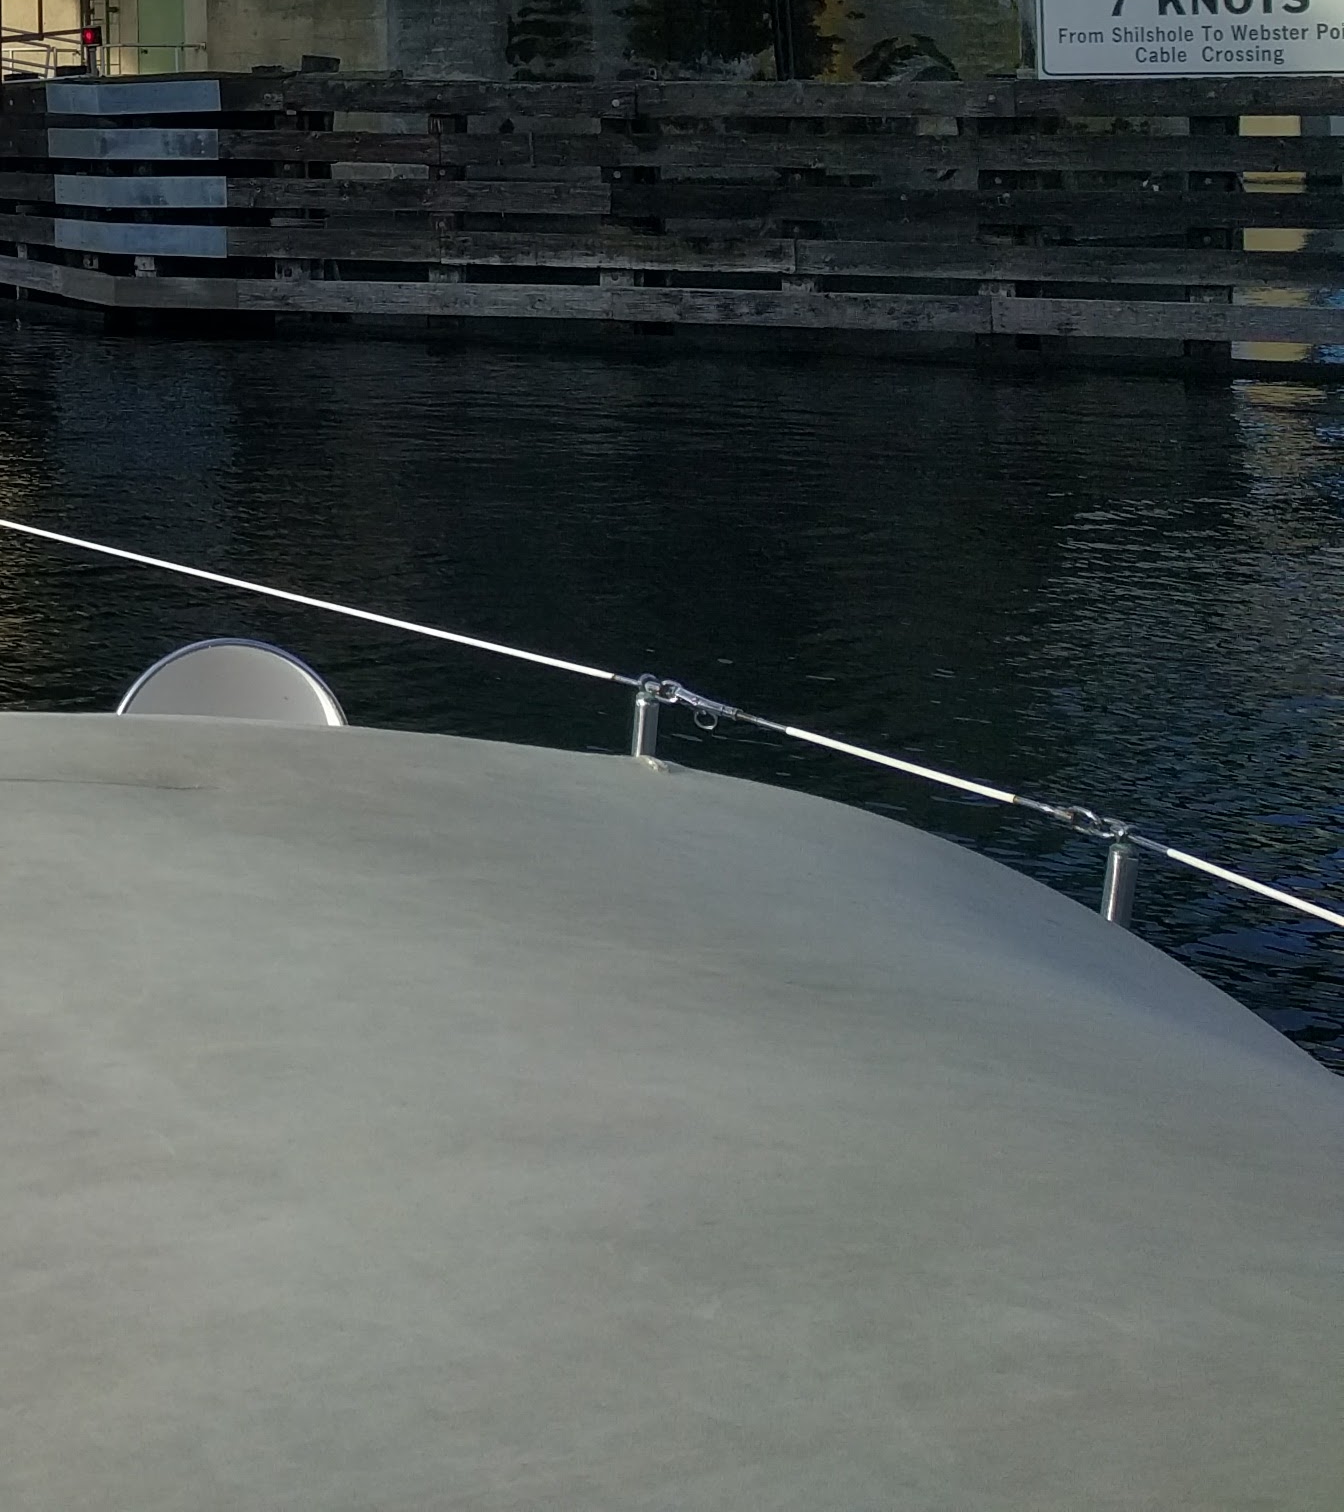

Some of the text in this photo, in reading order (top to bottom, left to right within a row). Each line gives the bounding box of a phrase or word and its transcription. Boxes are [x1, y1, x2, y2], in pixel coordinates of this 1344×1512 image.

[1058, 27, 1105, 44] From
[1111, 25, 1194, 44] Shilshole
[1201, 25, 1224, 43] To
[1230, 24, 1309, 42] Webster
[1135, 44, 1285, 65] Cable Crossing
